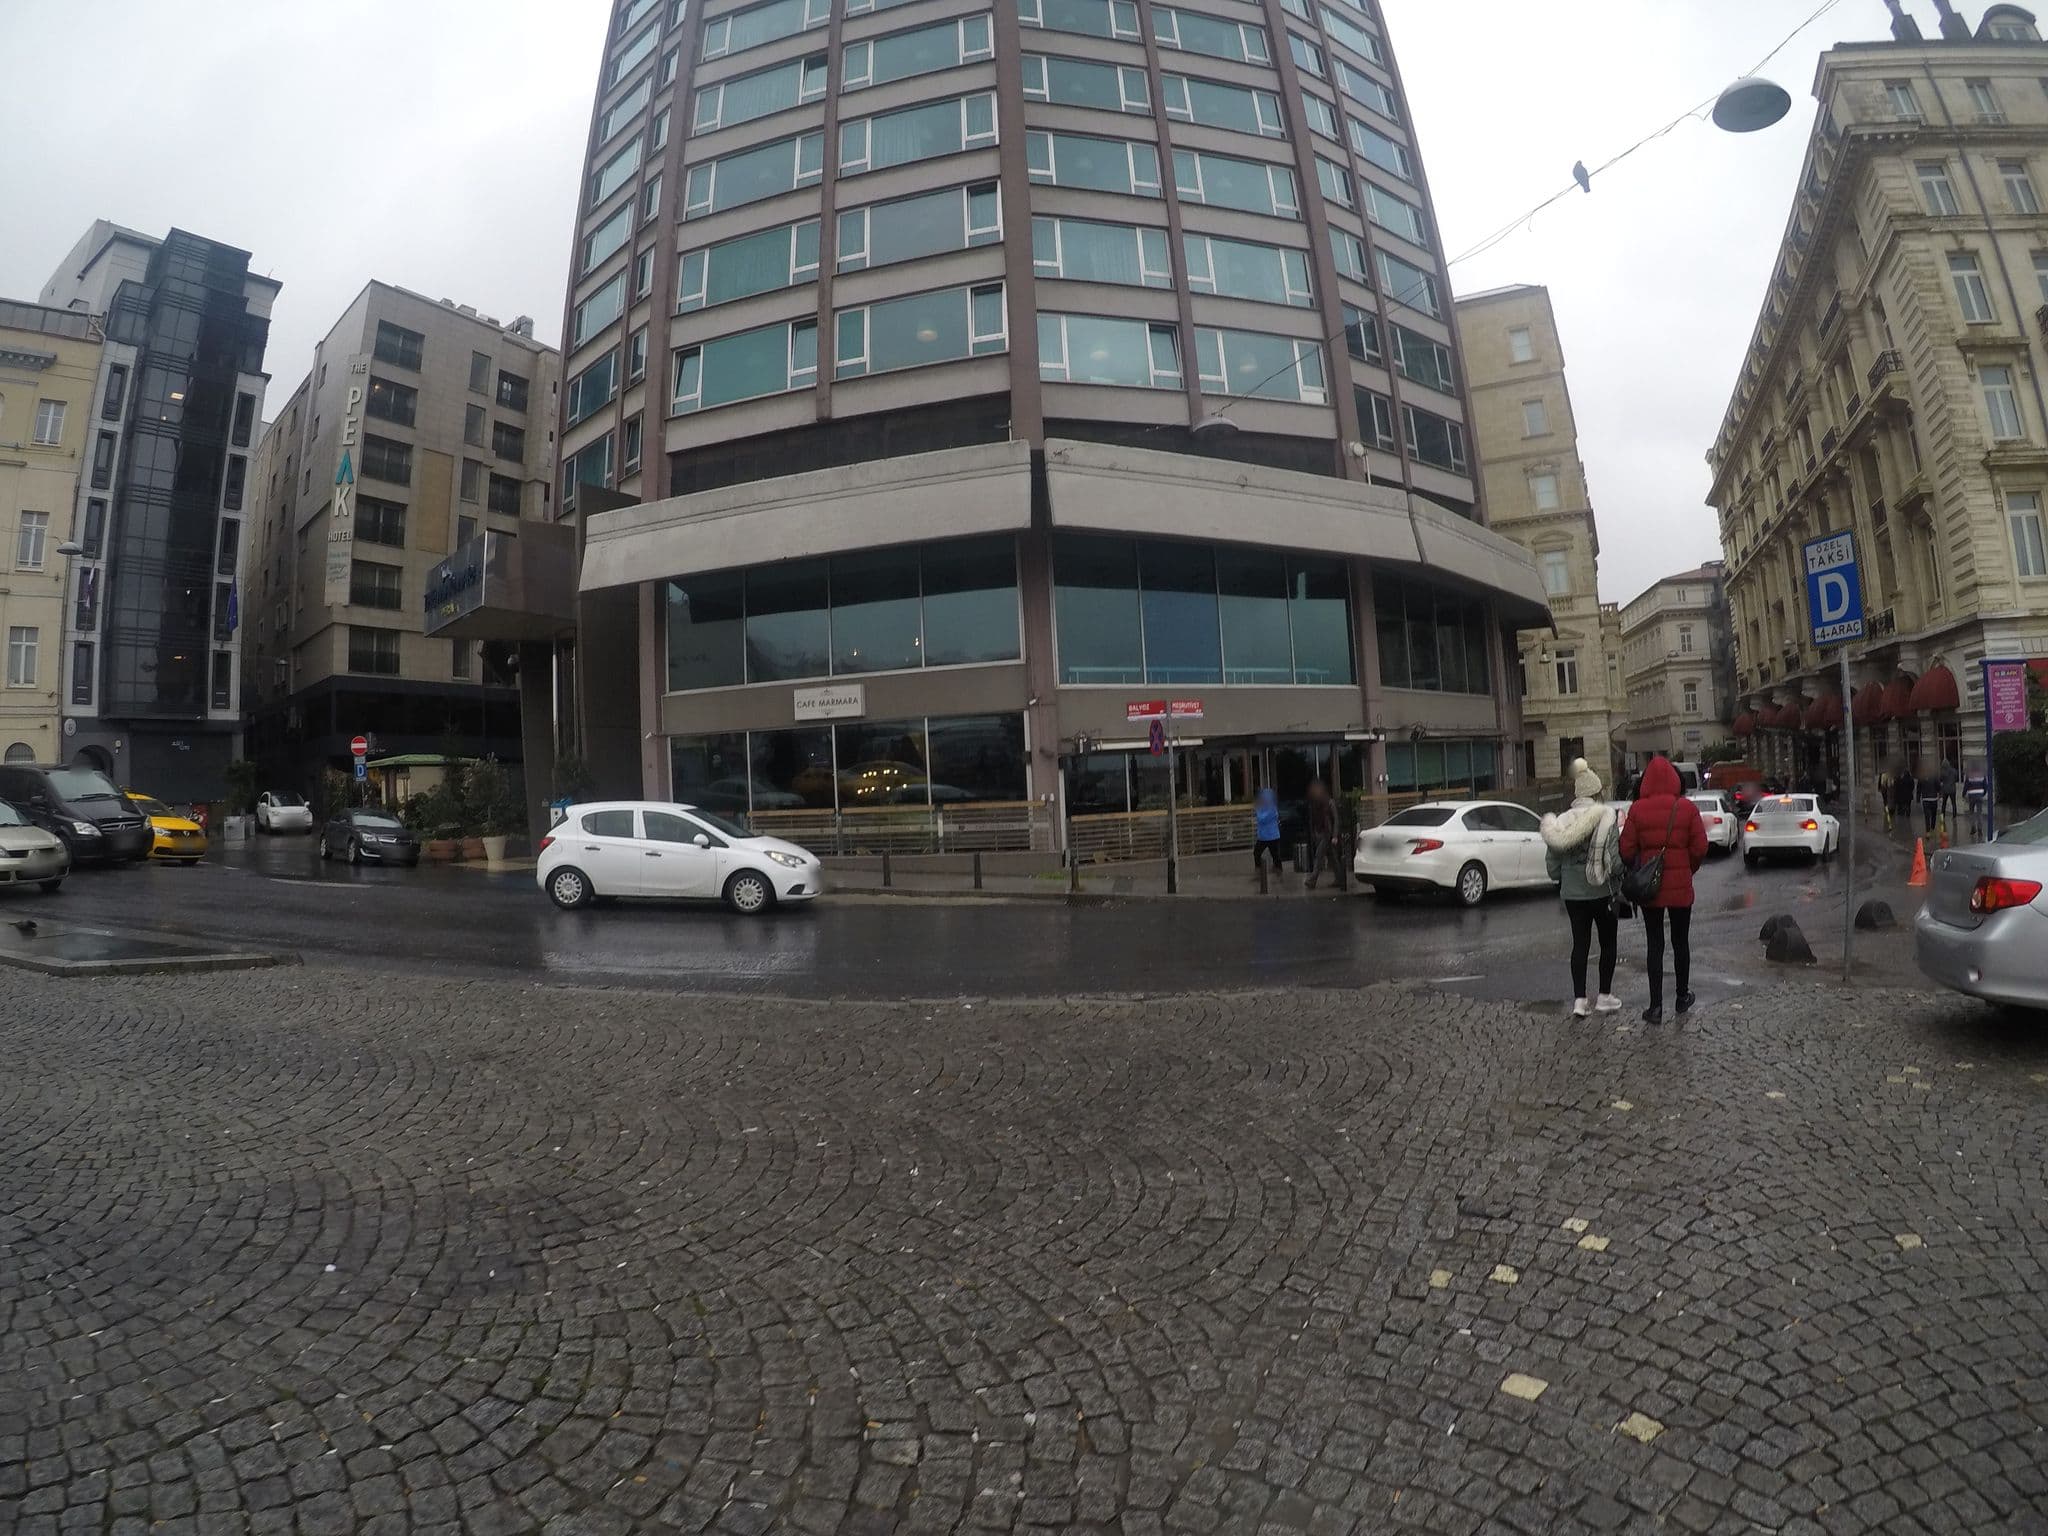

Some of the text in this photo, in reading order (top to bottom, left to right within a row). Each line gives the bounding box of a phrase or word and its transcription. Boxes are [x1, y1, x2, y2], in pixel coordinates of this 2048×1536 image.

[351, 363, 367, 374] THE
[335, 386, 362, 517] PEAK
[327, 531, 353, 543] HOTEL
[1816, 541, 1841, 554] ÖZEL
[1809, 545, 1849, 569] TAKSİ
[1818, 572, 1850, 623] D
[797, 697, 858, 708] CAFE MARMARA
[357, 765, 365, 776] D
